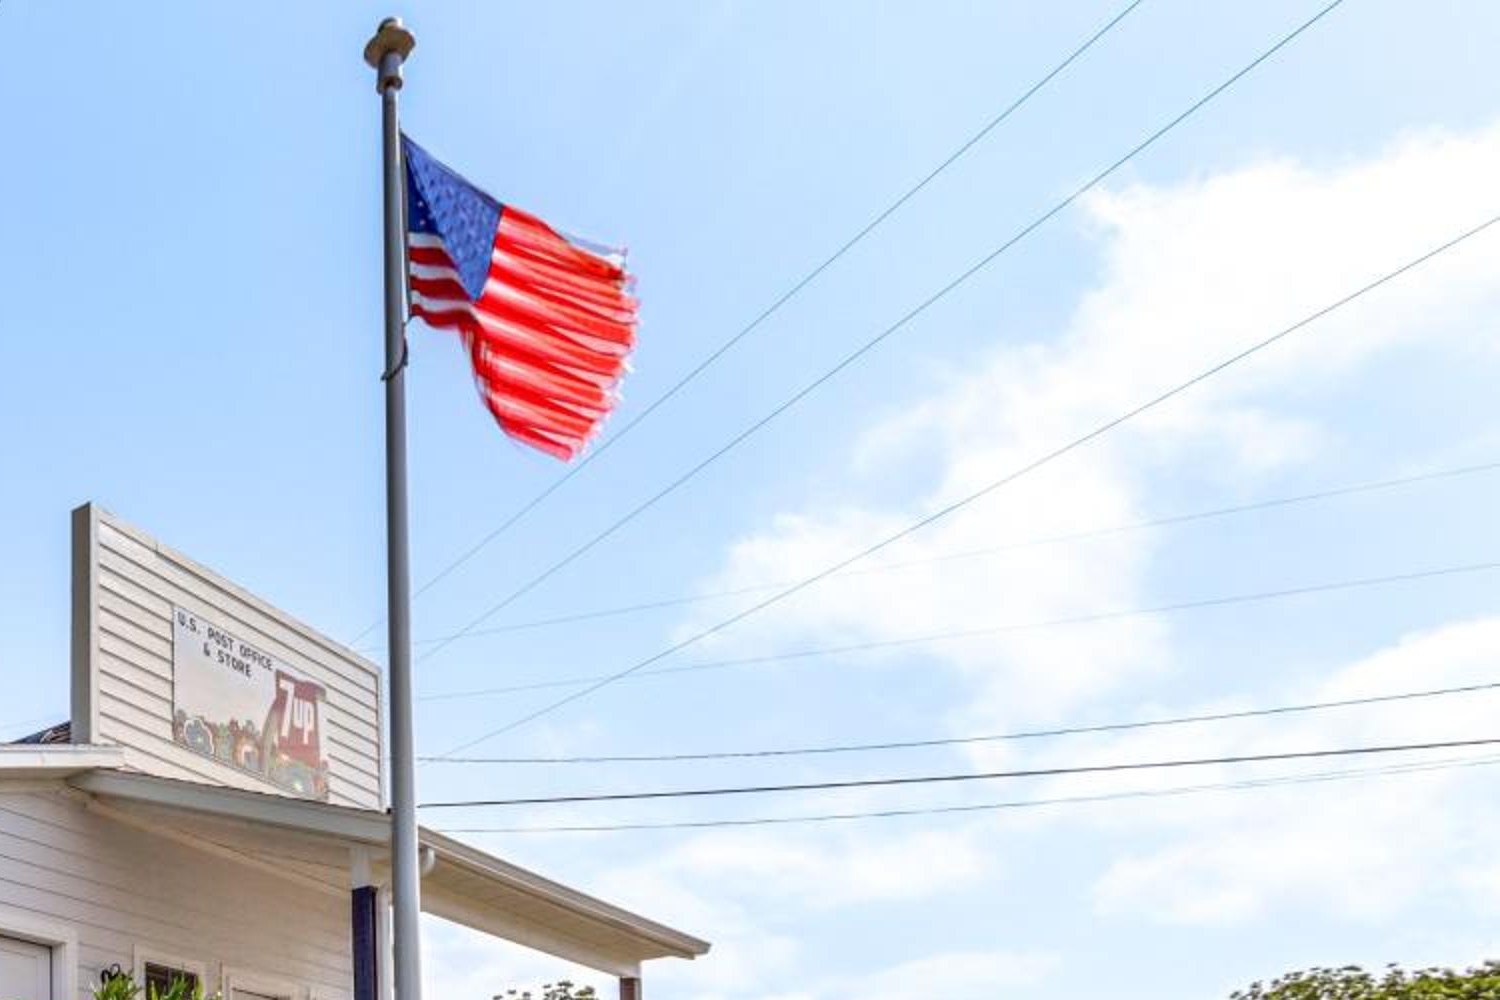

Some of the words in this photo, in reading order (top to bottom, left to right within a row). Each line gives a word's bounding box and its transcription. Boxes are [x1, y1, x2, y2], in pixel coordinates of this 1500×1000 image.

[207, 626, 234, 651] POST
[239, 644, 273, 671] OFFICE
[217, 649, 252, 678] STORE
